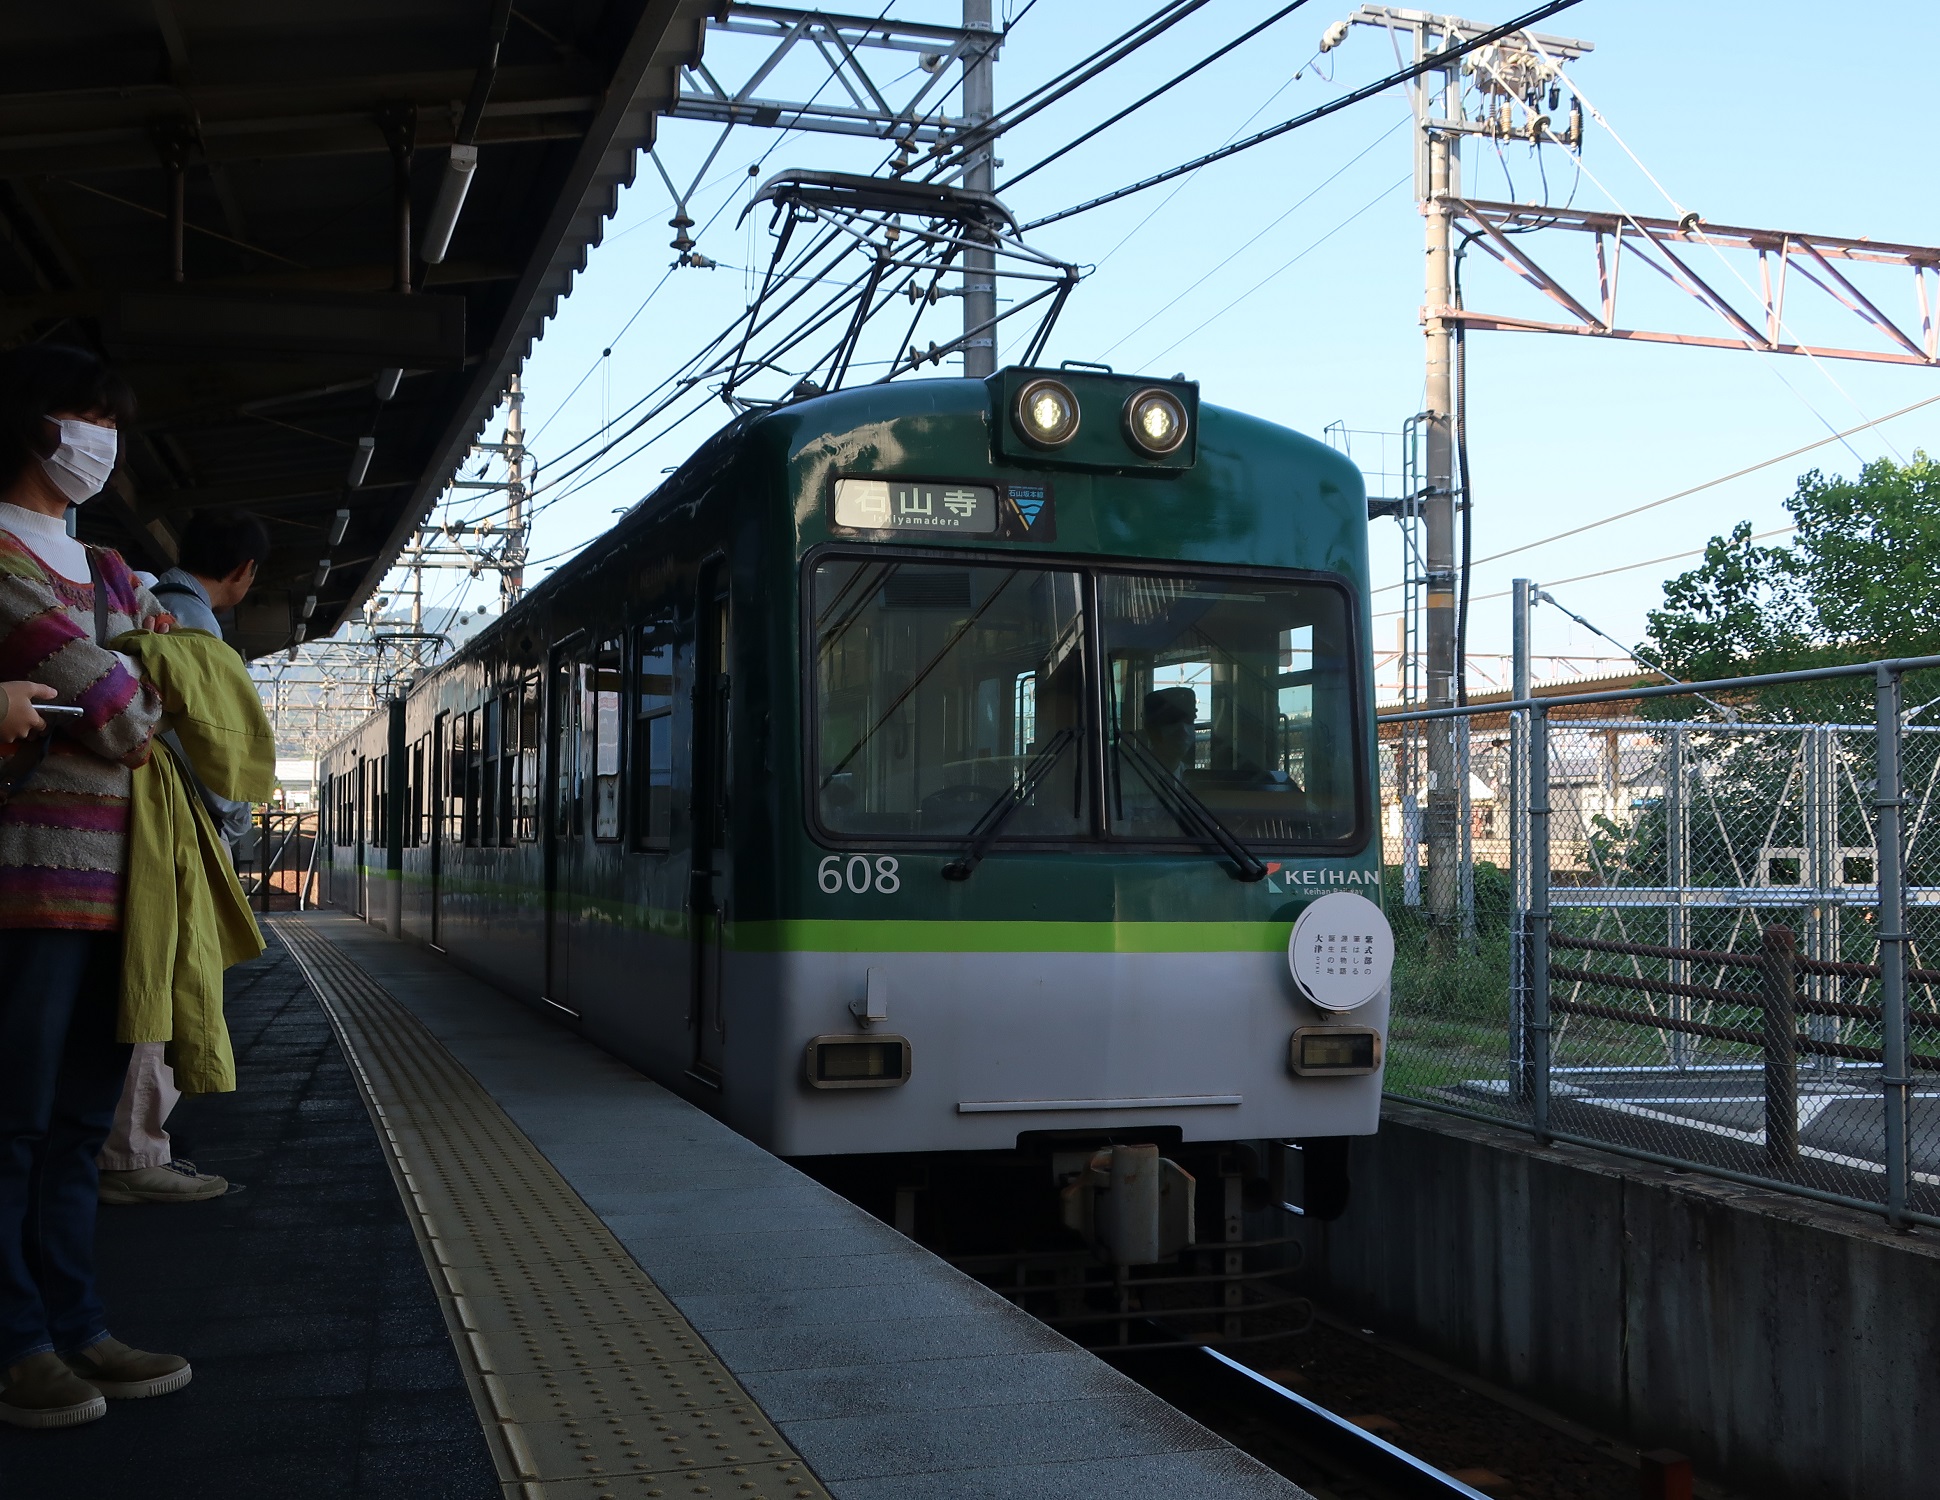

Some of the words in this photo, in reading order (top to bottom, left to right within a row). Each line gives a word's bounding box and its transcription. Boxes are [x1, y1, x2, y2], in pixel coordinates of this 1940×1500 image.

[853, 485, 977, 517] 石山寺
[873, 514, 960, 527] Ishiyamadera
[817, 855, 901, 894] 608
[1285, 868, 1380, 885] KEIHAN
[1303, 887, 1331, 895] Keihan
[1314, 934, 1323, 953] 大津
